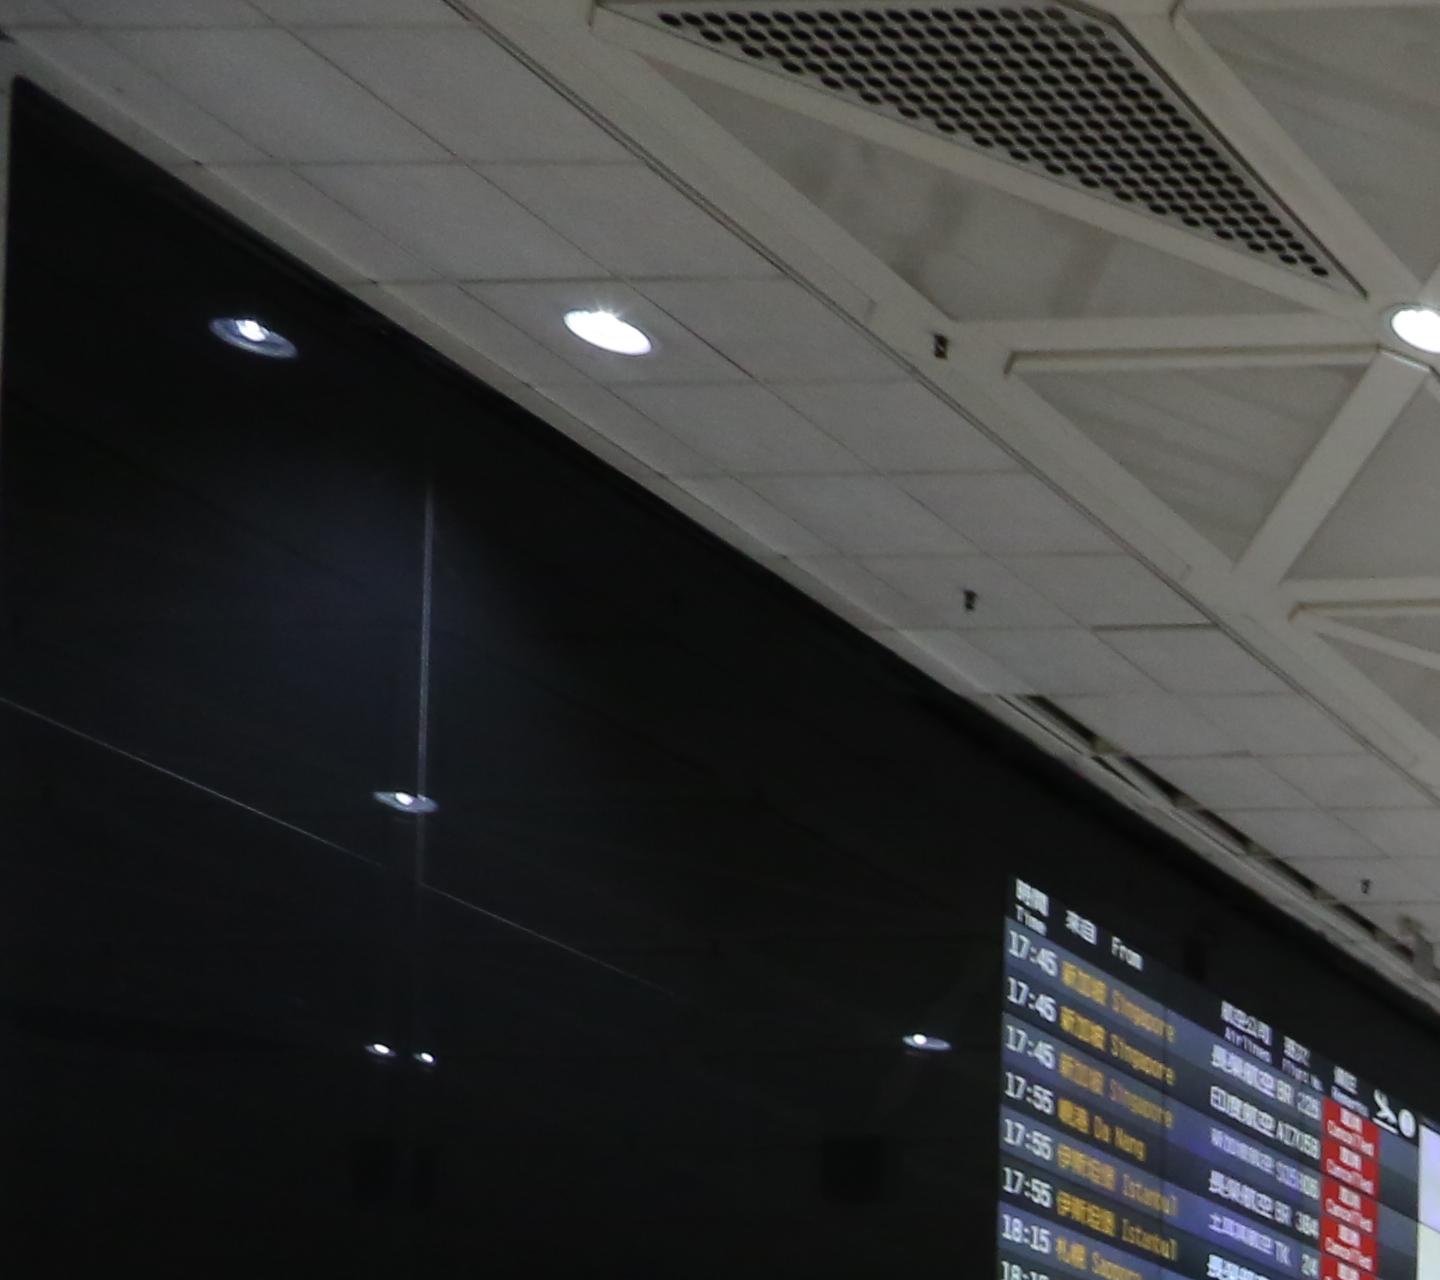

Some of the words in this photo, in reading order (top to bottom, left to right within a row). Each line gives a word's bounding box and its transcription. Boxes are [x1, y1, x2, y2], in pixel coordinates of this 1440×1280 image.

[1010, 930, 1057, 978] 17:45
[1008, 976, 1056, 1023] 17:45
[1007, 1024, 1054, 1070] 17:45
[1005, 1070, 1053, 1115] 17:55
[1004, 1118, 1051, 1161] 17:55
[1003, 1166, 1051, 1208] 17:55
[1003, 1214, 1050, 1254] 18:15
